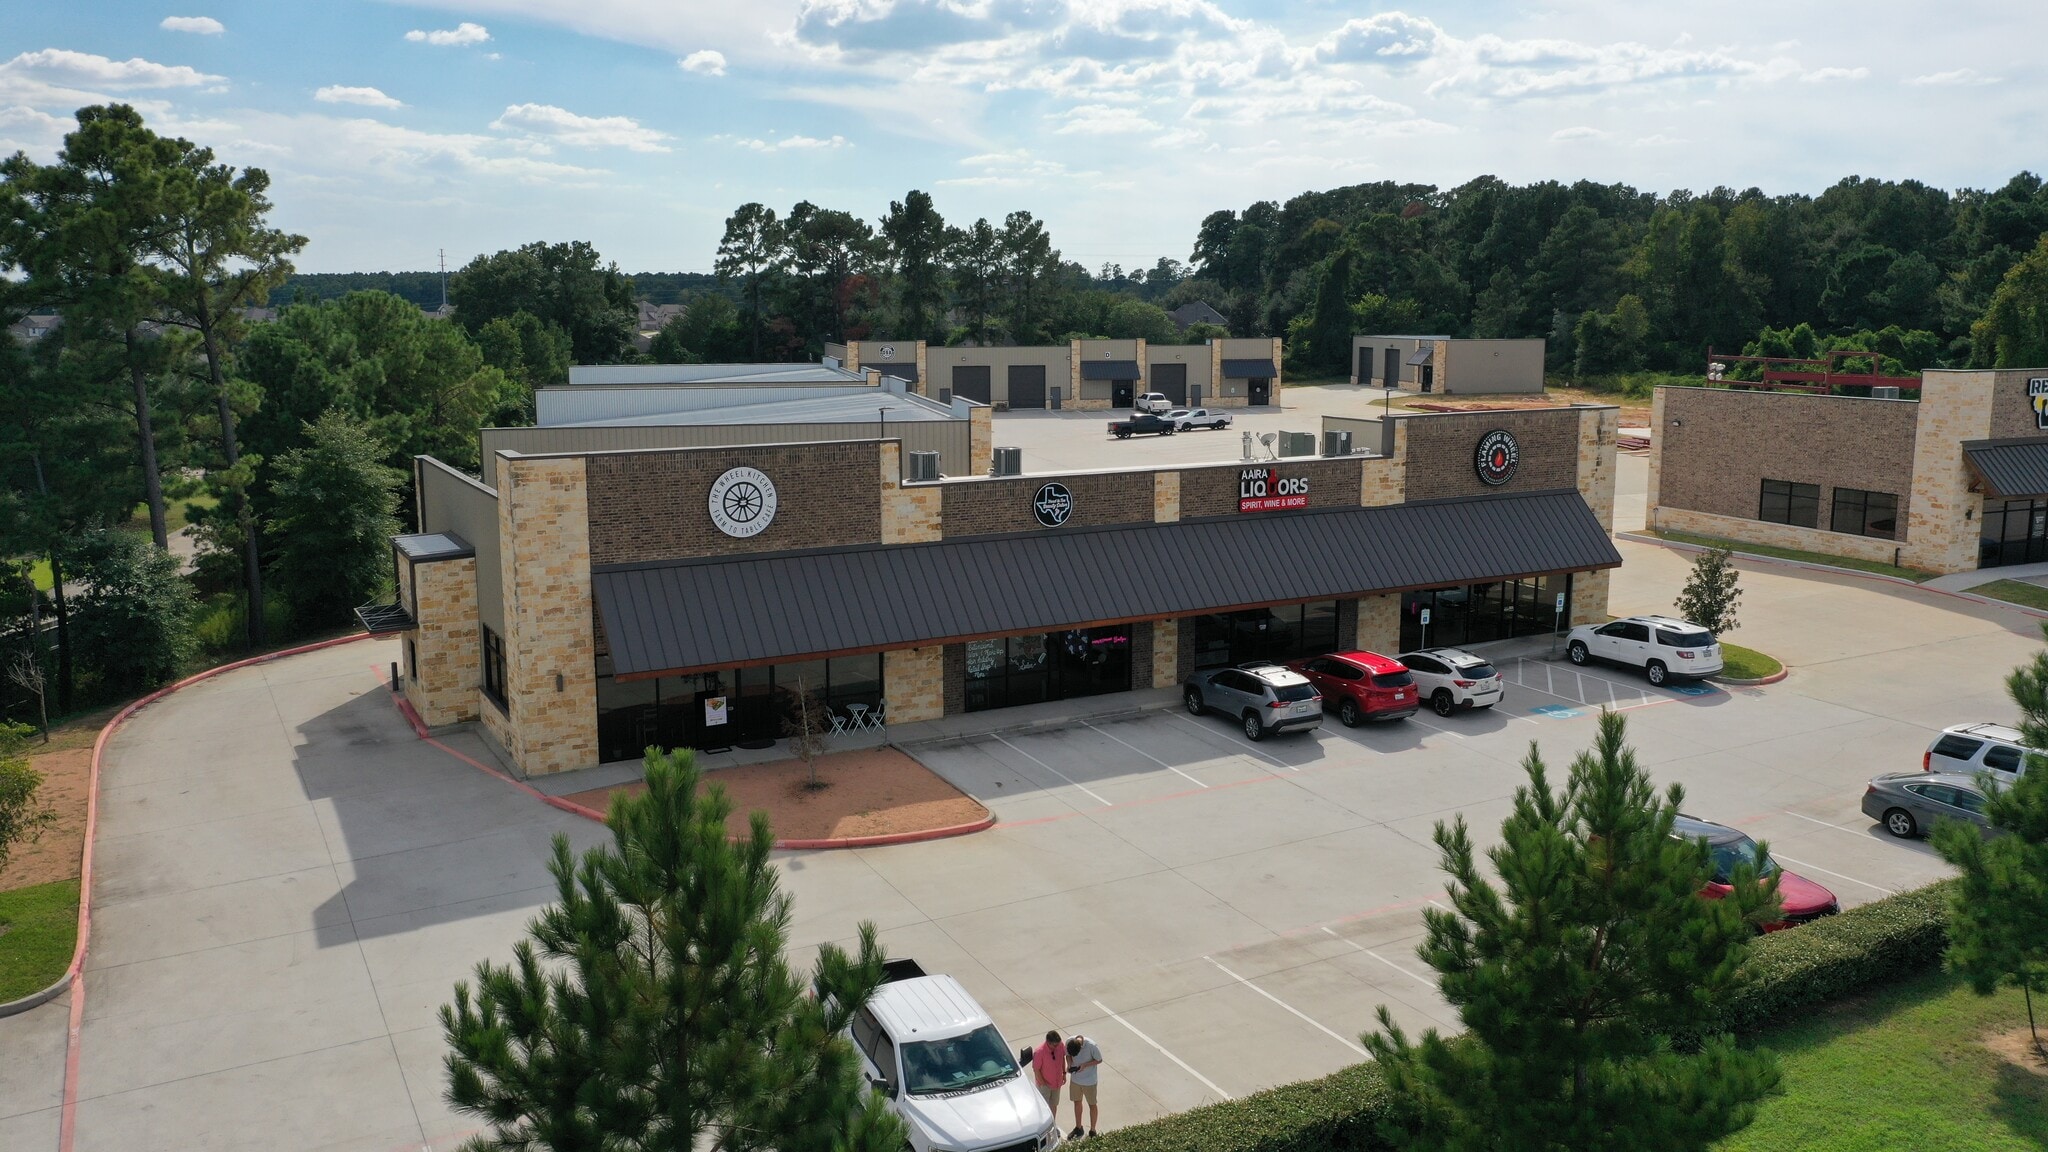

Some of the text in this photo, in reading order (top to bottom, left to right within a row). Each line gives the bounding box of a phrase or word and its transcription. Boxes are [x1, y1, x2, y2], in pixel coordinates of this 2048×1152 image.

[1481, 434, 1516, 467] FLAMING WHEEL
[711, 470, 773, 504] THE WHEEL KITCHEN
[1241, 469, 1268, 480] AAIRA
[1241, 497, 1306, 510] SPIRIT, WINE & MORE
[713, 509, 727, 528] FARM
[728, 524, 738, 534] TO
[741, 522, 762, 535] TABLE
